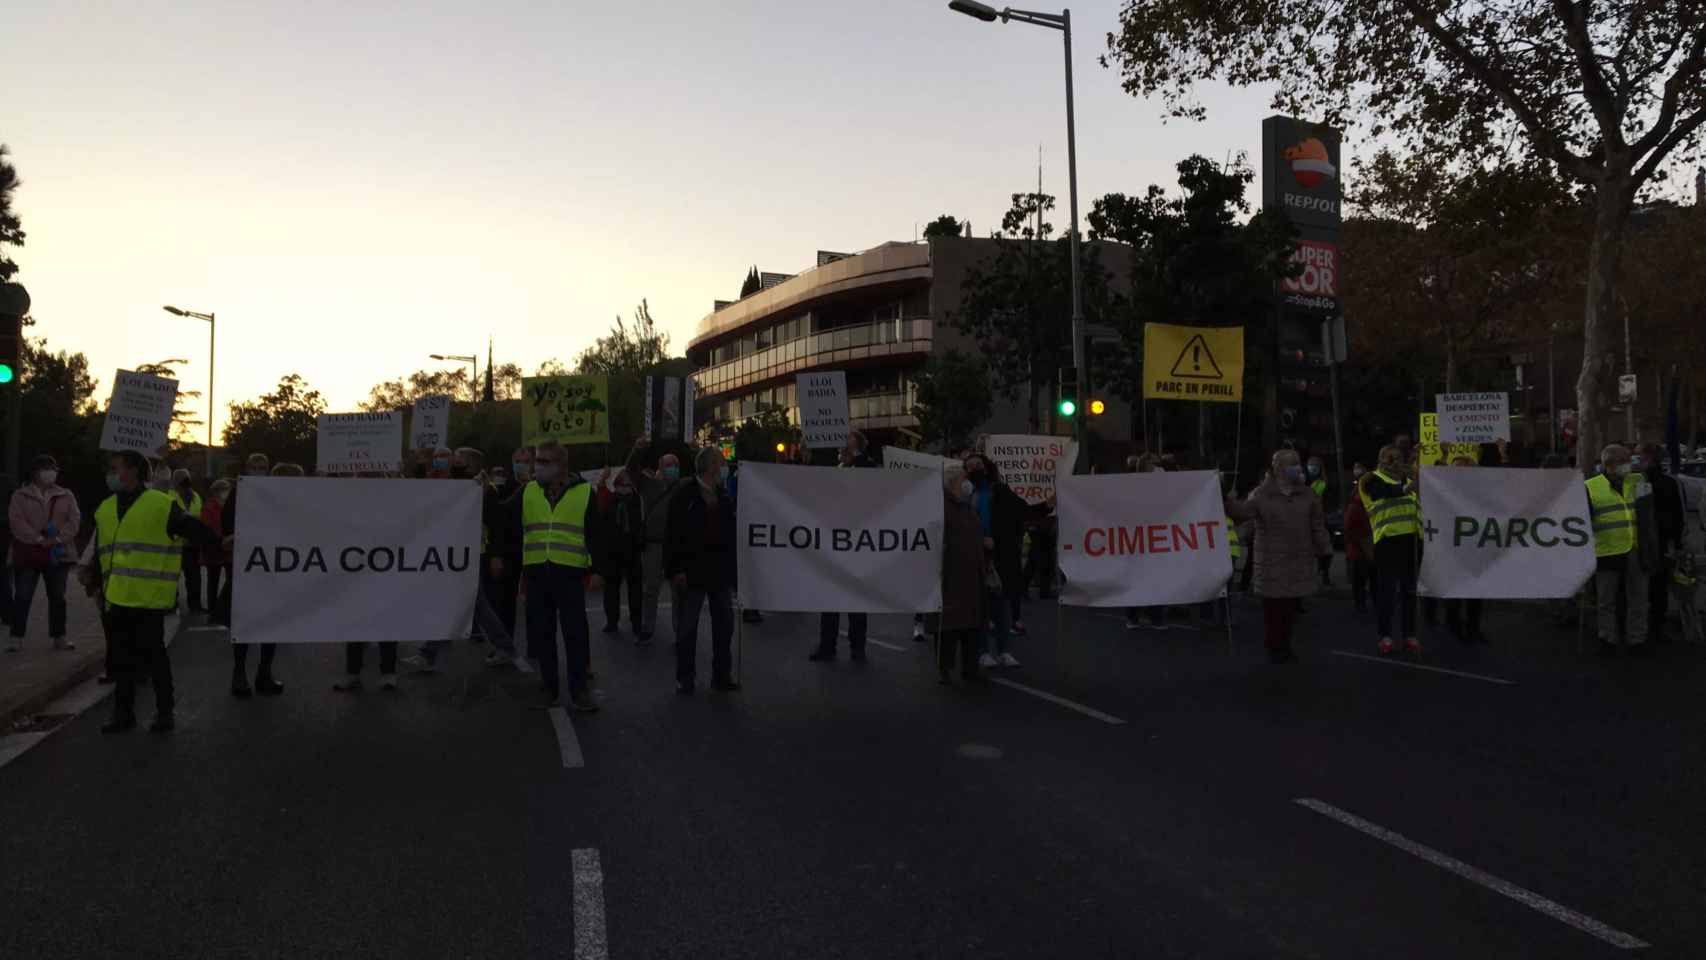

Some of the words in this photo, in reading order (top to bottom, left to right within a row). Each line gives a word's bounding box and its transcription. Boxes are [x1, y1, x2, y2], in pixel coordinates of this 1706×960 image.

[1283, 193, 1337, 213] REPSOL
[1156, 381, 1183, 393] PARC
[1185, 383, 1198, 394] EN
[1443, 392, 1502, 402] BARCELONA
[993, 446, 1046, 456] INSTITUT
[1033, 458, 1056, 471] NO
[749, 524, 820, 550] ELOI
[832, 528, 930, 551] BADIA
[1084, 521, 1220, 557] CIMENT
[1453, 516, 1589, 548] PARCS
[244, 546, 327, 572] ADA
[339, 546, 470, 572] COLAU
